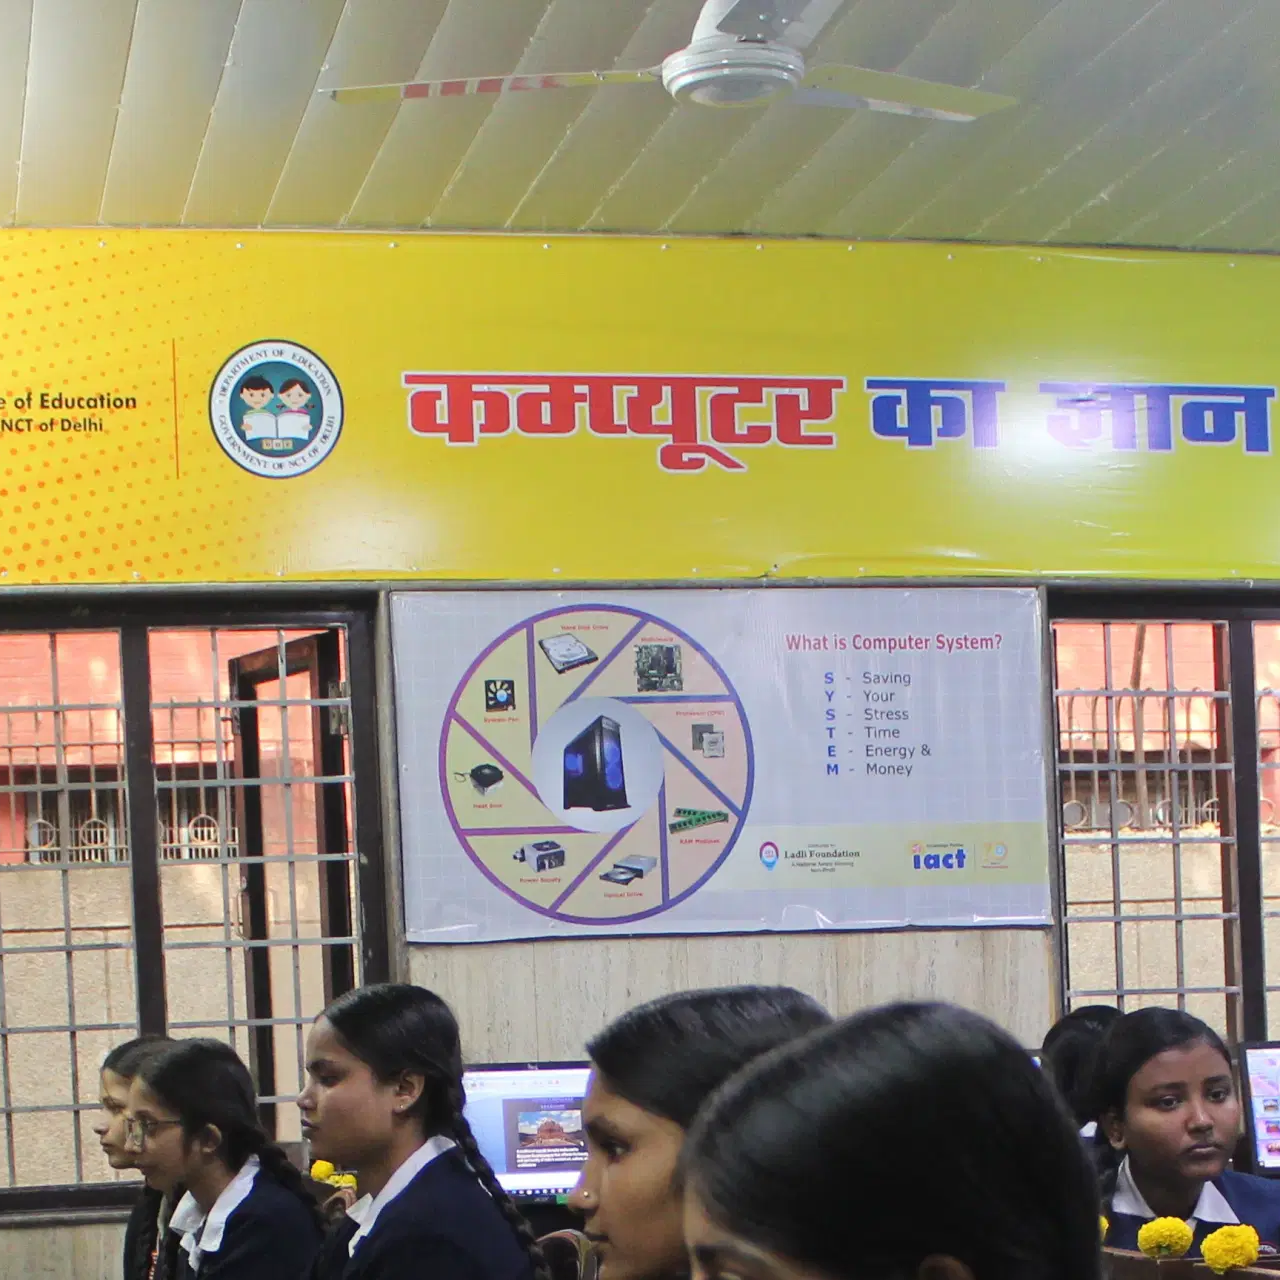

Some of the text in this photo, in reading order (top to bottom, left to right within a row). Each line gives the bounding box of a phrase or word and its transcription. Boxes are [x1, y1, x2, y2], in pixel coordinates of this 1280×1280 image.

[219, 349, 332, 397] DEPARTMENT OF EDUCATION
[14, 392, 32, 409] of
[40, 392, 136, 409] Education
[1, 419, 33, 433] NCT
[39, 418, 55, 432] of
[61, 418, 103, 432] Delhi
[403, 373, 845, 471] कम्प्यूटर
[865, 378, 1006, 448] का
[219, 414, 268, 469] GOVERNMENT
[272, 462, 284, 470] OF
[289, 456, 307, 468] NCT
[320, 415, 335, 445] DELHI
[786, 634, 1002, 653] What is Computer System?
[824, 672, 834, 684] S
[862, 672, 911, 686] Saving
[825, 690, 834, 702] Y
[863, 690, 895, 702] Your
[826, 709, 835, 721] S
[864, 708, 909, 720] Stress
[826, 727, 836, 739] T
[864, 726, 900, 738] Time
[828, 745, 836, 757] E
[865, 744, 915, 759] Energy
[921, 744, 931, 757] &
[827, 764, 839, 775] M
[866, 763, 912, 776] Money
[784, 850, 860, 859] Ladli Foundation
[912, 844, 966, 870] iact
